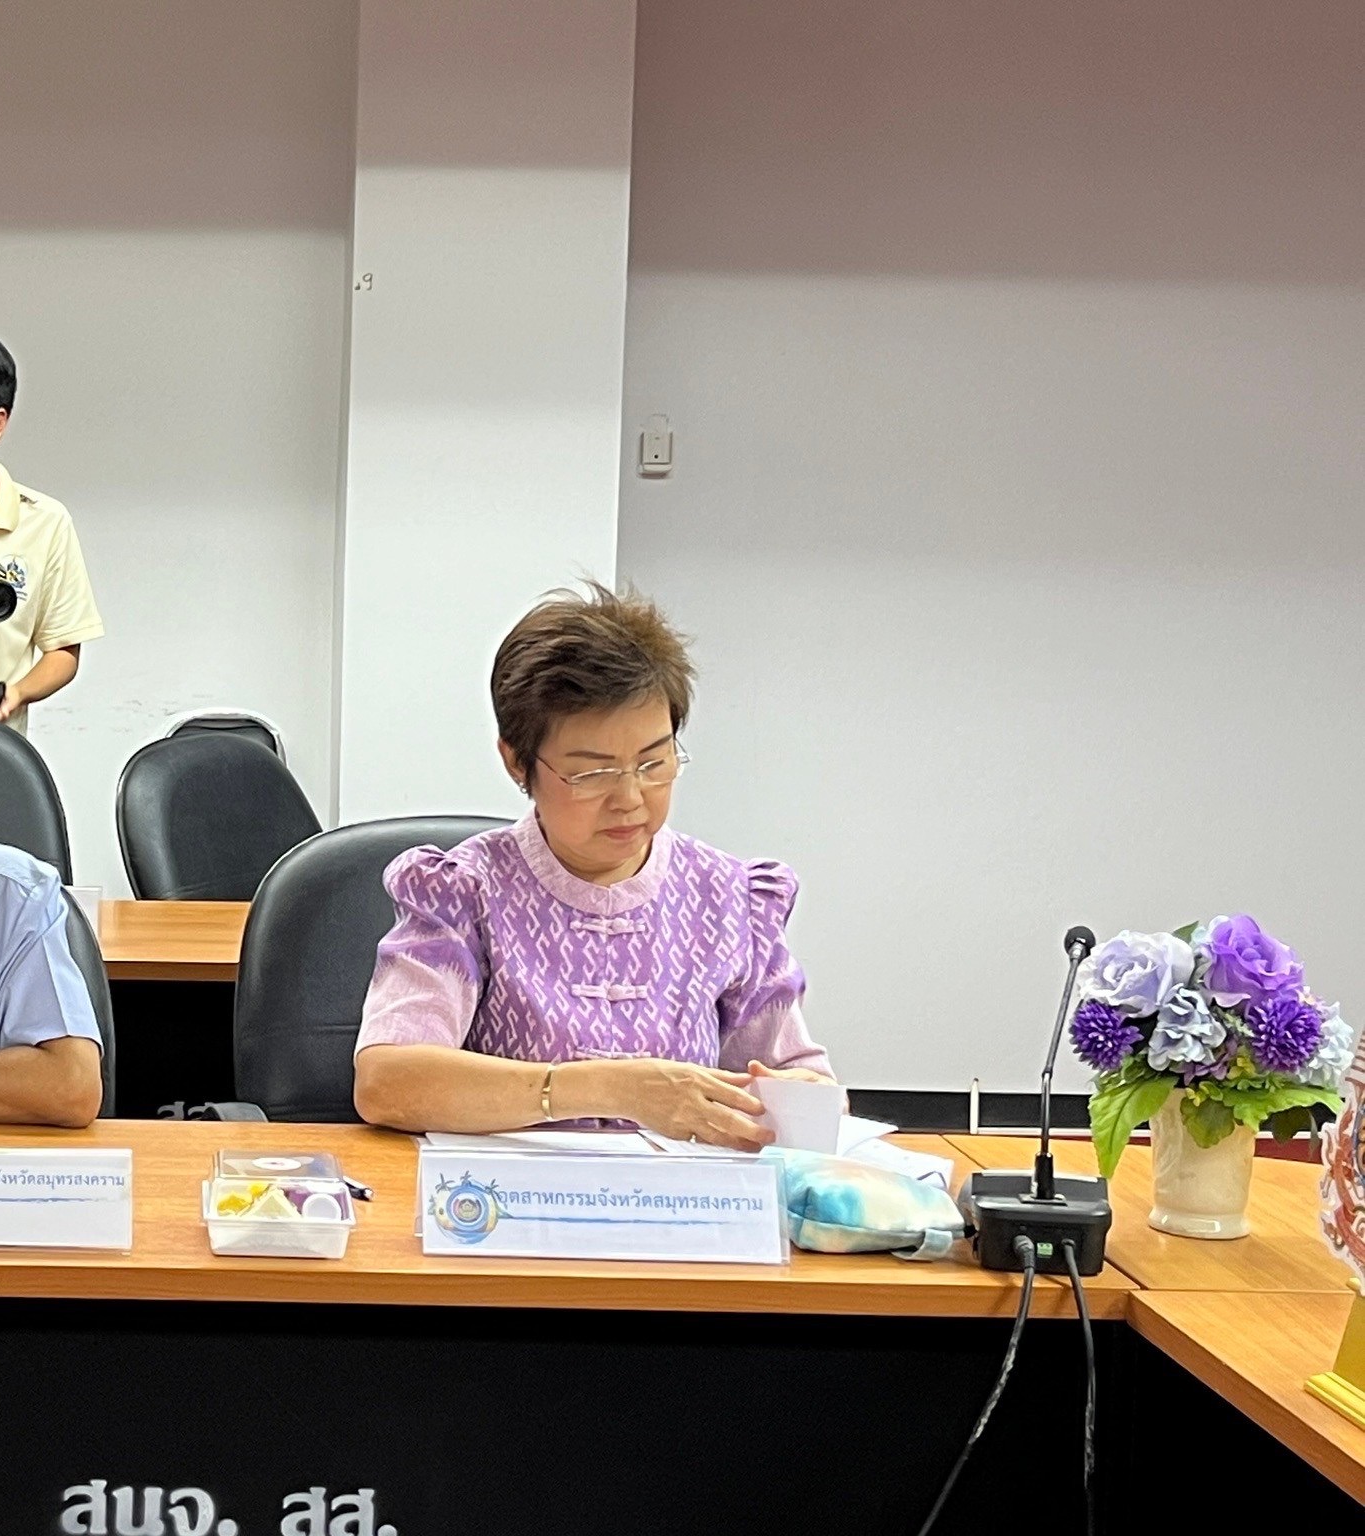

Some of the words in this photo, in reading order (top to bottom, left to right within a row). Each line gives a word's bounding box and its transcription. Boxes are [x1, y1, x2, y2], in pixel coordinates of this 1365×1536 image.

[497, 1187, 763, 1215] อุตสาหกรรมจังหวัดสมุทรสงคราม
